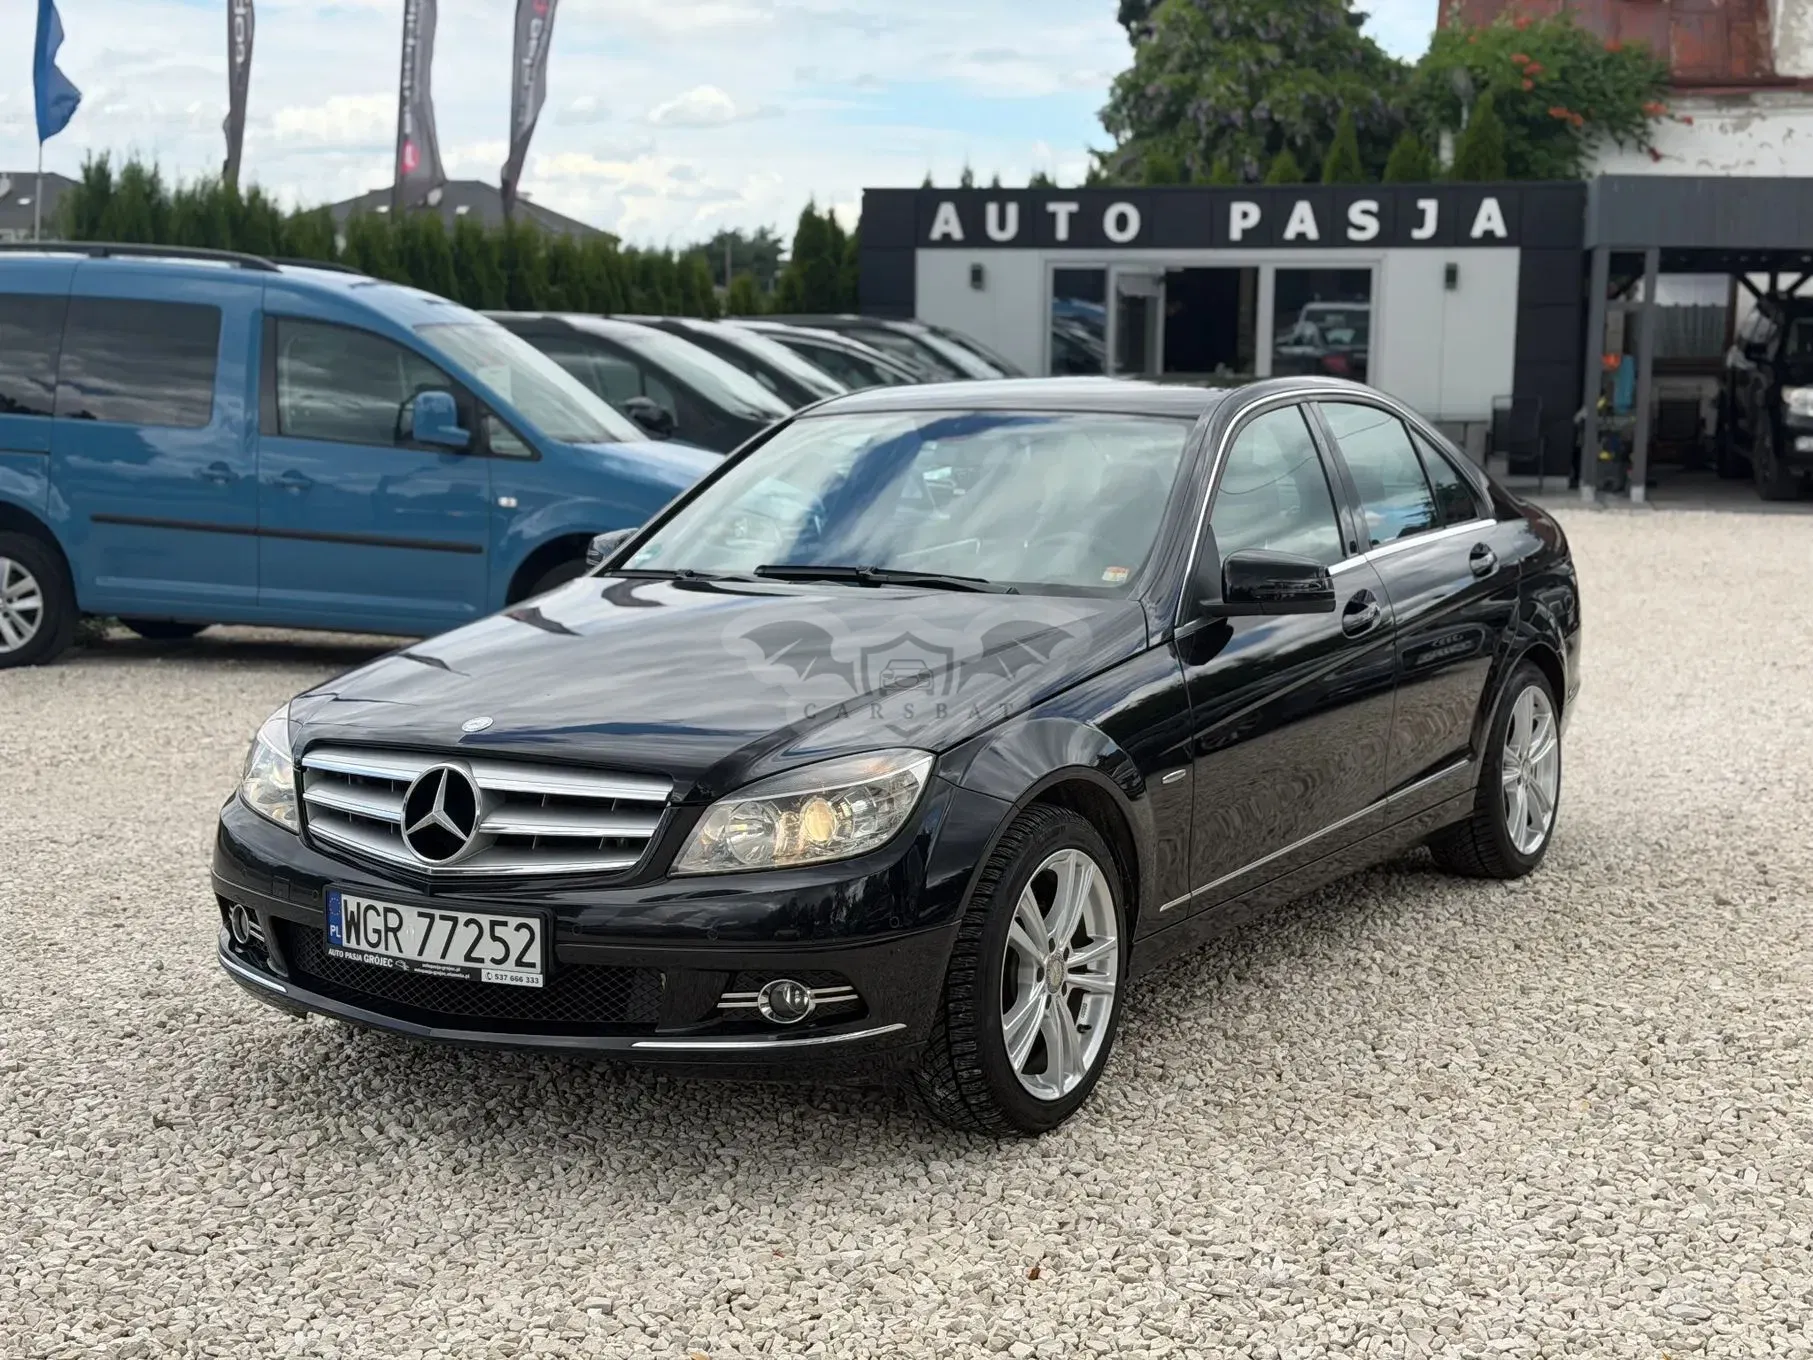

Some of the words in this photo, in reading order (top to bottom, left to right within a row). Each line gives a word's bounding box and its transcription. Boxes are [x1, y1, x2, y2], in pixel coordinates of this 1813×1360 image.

[929, 201, 1142, 242] AUTO
[1228, 197, 1508, 241] PASJA
[329, 925, 342, 938] PL
[343, 899, 404, 954] WGR
[417, 911, 537, 969] 77252
[328, 948, 344, 958] AUTO
[345, 952, 363, 962] PASJA
[363, 954, 394, 968] GRÓJEC
[510, 975, 524, 983] 666
